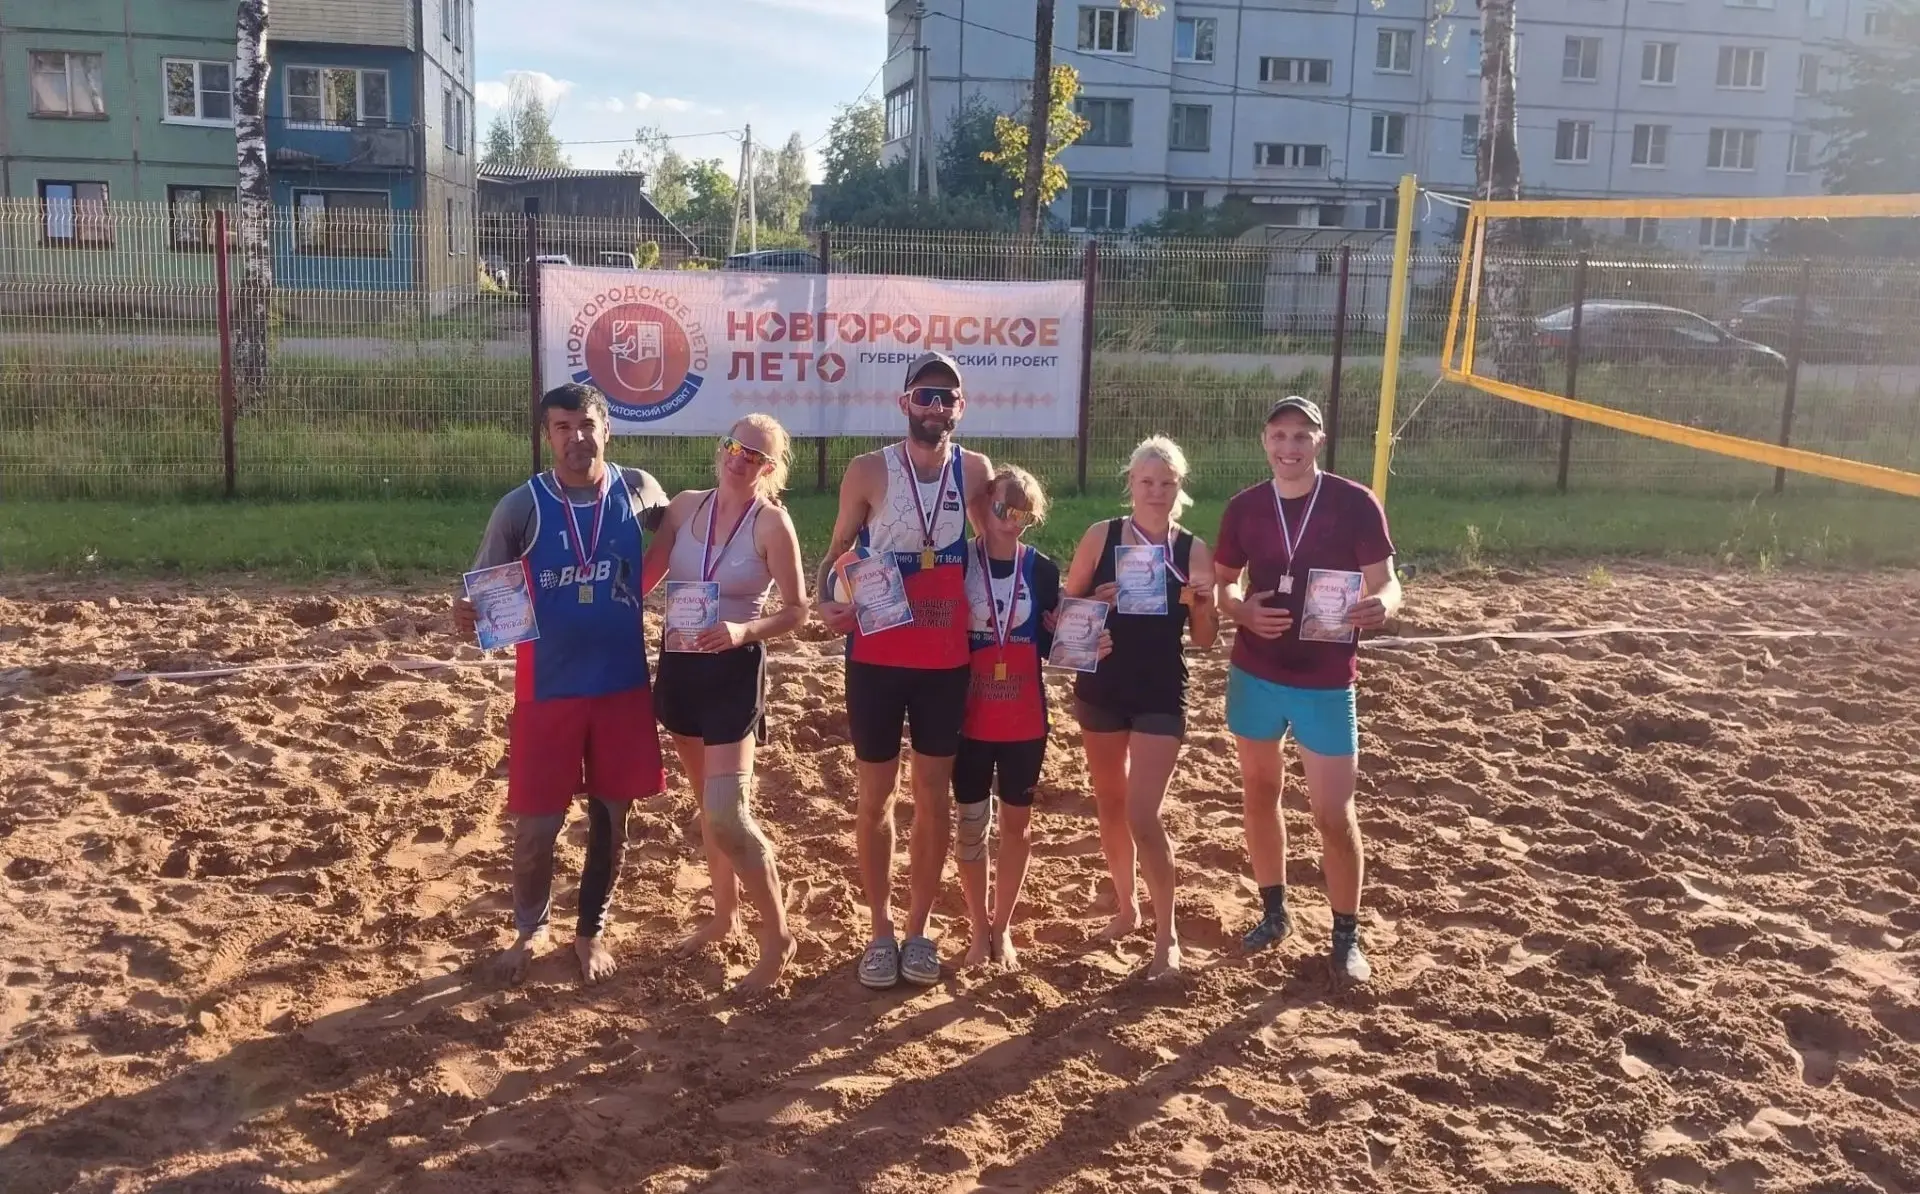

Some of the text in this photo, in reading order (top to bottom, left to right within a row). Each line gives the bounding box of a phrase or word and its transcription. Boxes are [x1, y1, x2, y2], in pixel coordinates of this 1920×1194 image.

[567, 285, 709, 371] НОВГОРОДСКОЕ ЛЕТО
[728, 312, 1061, 350] НОВГОРОДСКОЕ
[728, 352, 846, 383] ЛЕТО
[860, 352, 1058, 366] ГУБЕРНСКИЙ ПРОЕКТ
[608, 387, 690, 417] НАТОРСКИЙ ПРОЕКТ
